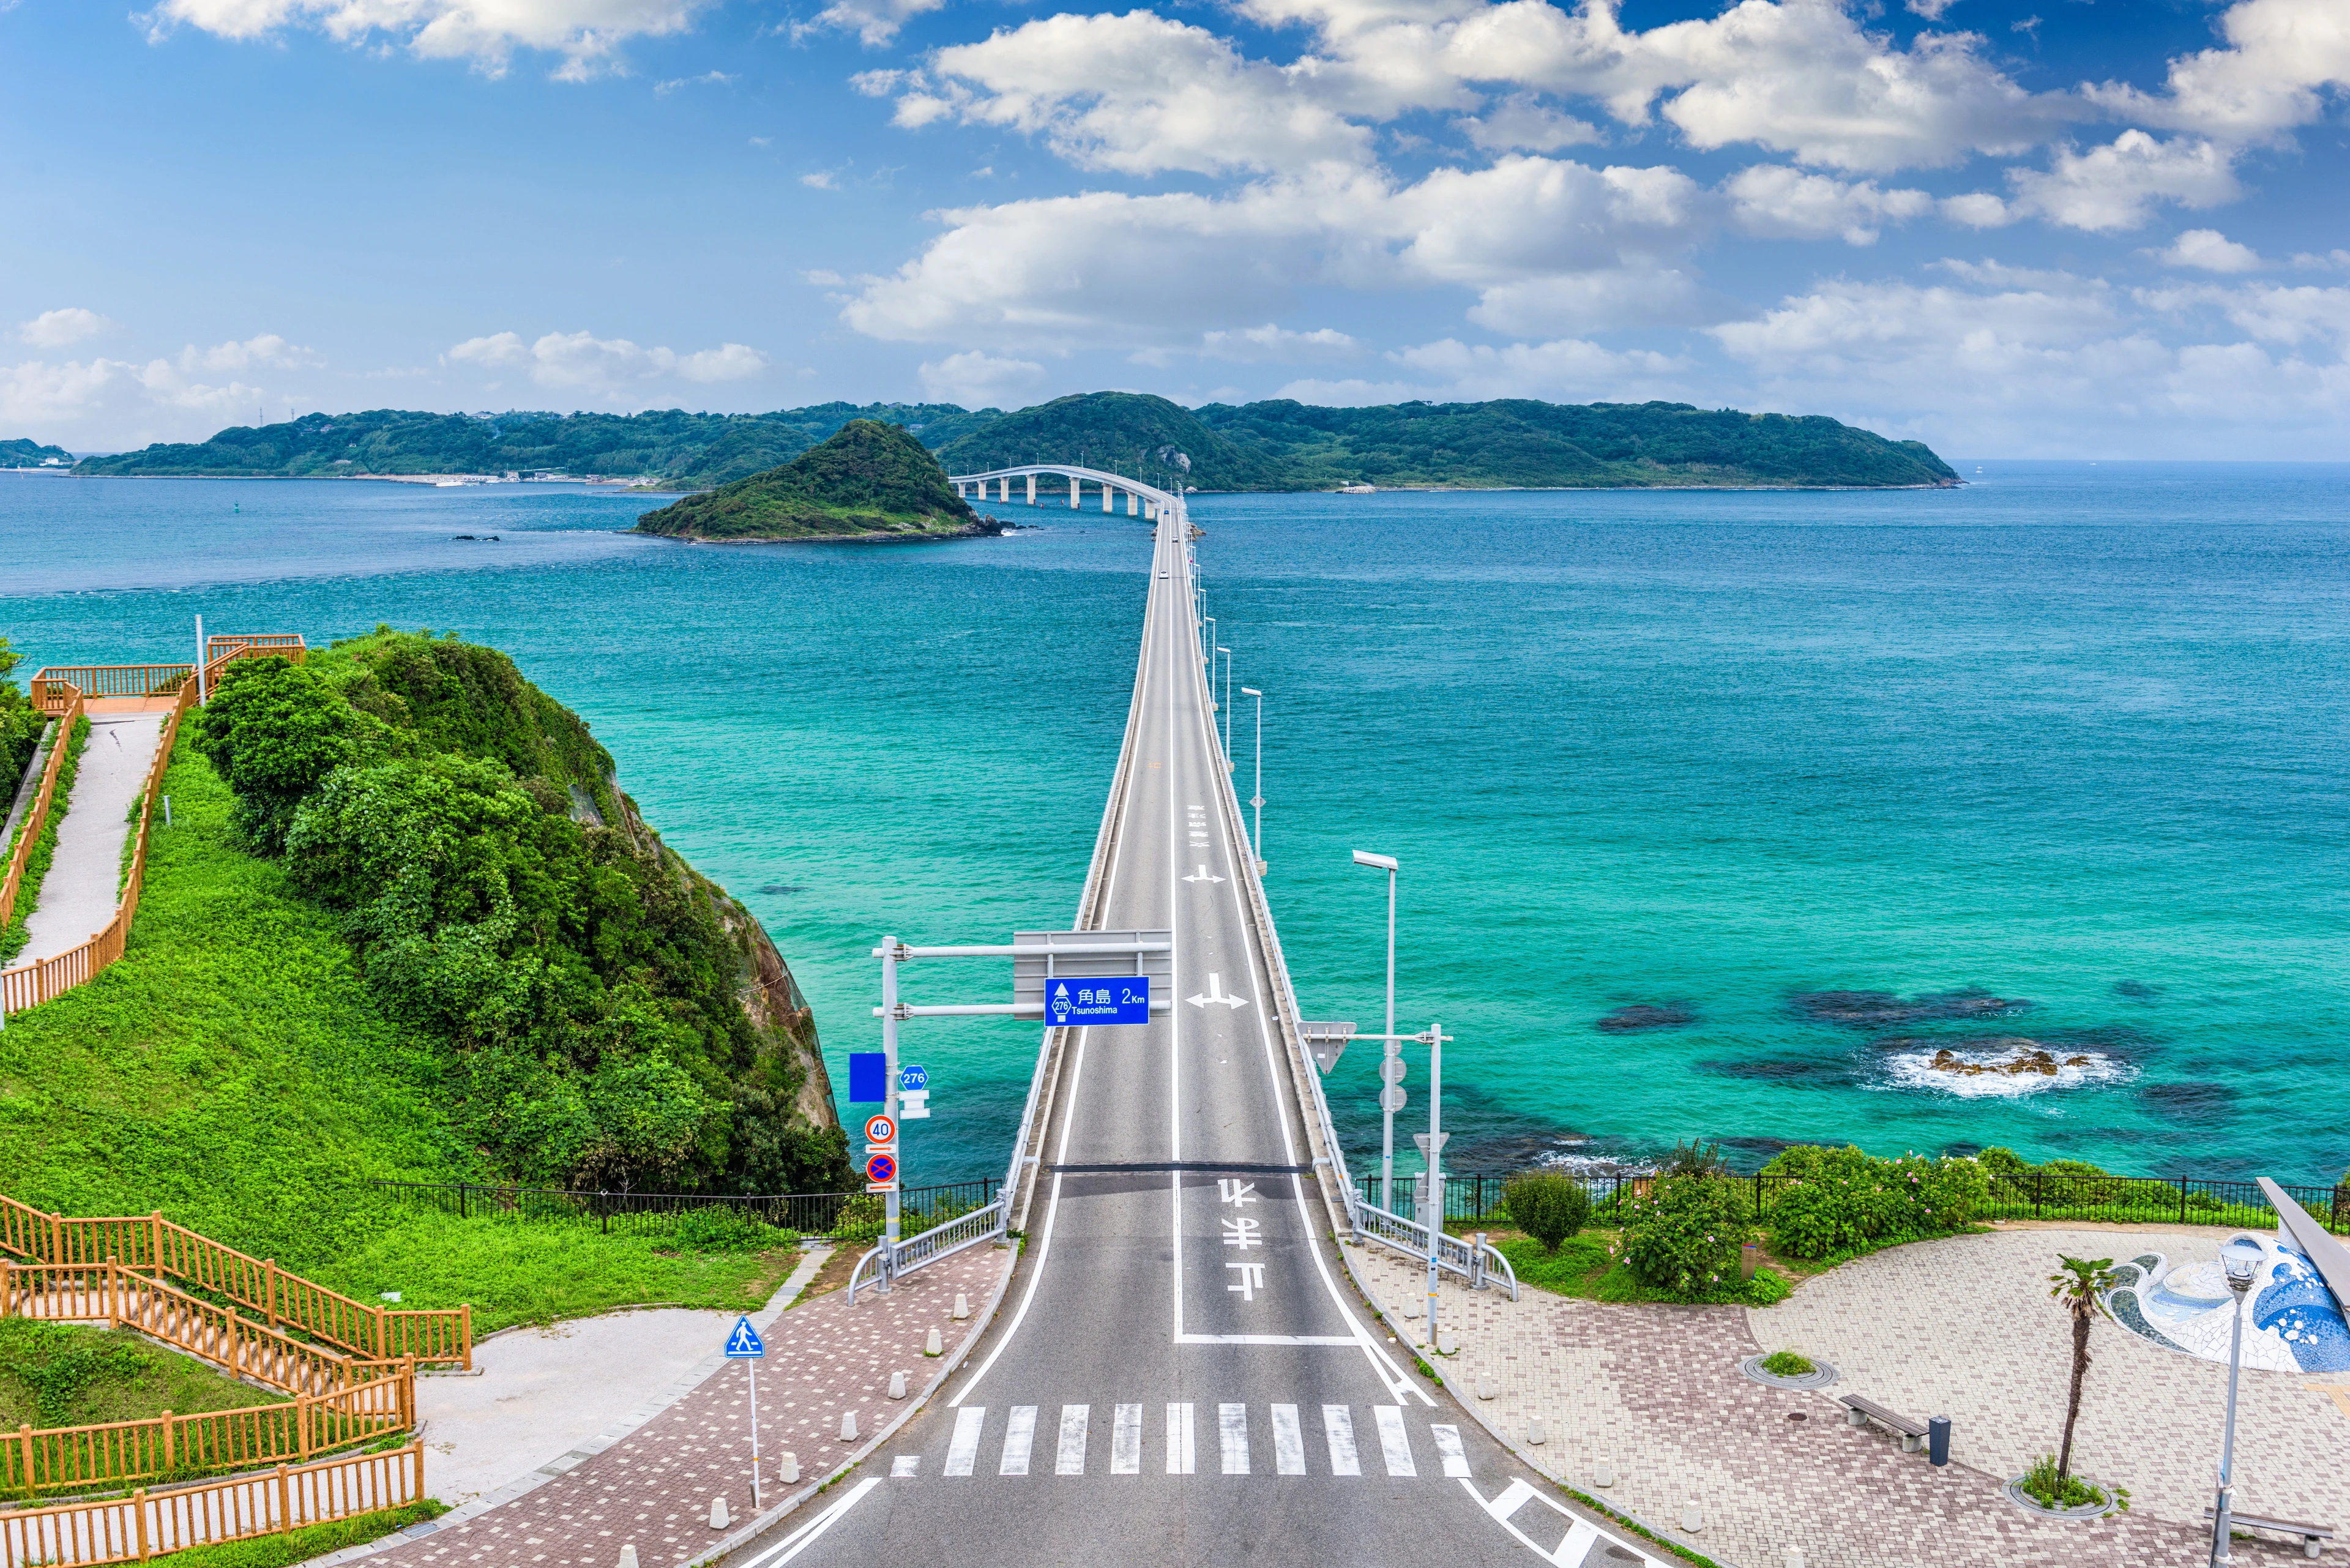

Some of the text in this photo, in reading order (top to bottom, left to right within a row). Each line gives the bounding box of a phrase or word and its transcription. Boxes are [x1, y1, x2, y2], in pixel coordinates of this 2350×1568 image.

[1078, 988, 1111, 1004] 角島
[1054, 1001, 1068, 1010] 276
[1072, 1006, 1117, 1015] Tsunoshima
[903, 1073, 925, 1083] 276
[873, 1123, 889, 1136] 40
[1217, 1179, 1265, 1301] 止まれ
